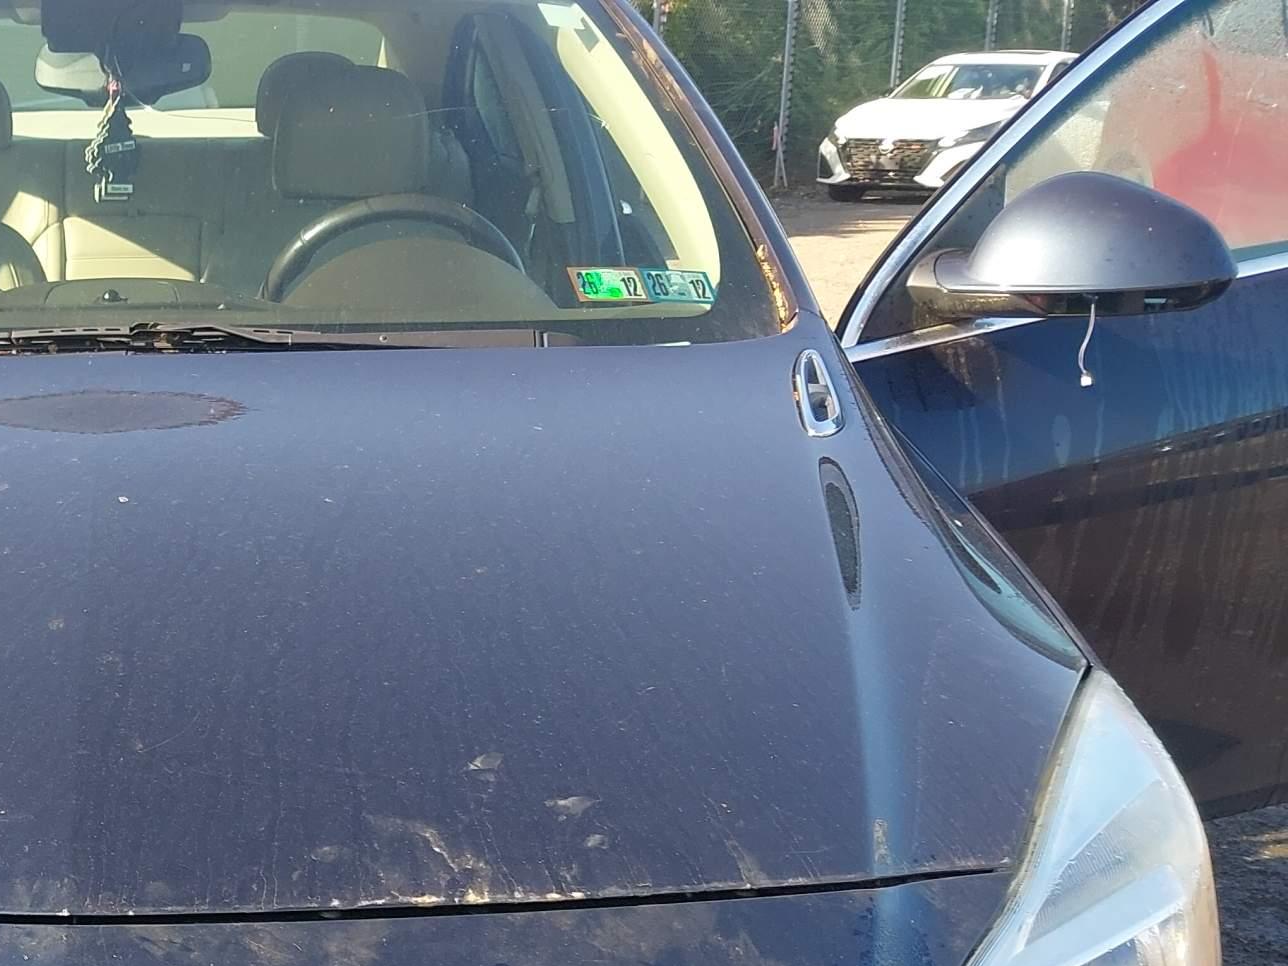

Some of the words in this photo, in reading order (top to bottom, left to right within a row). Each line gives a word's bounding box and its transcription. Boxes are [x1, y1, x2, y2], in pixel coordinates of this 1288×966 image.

[576, 271, 599, 295] 26
[620, 276, 643, 297] 12
[647, 272, 669, 296] 26
[688, 279, 711, 299] 12
